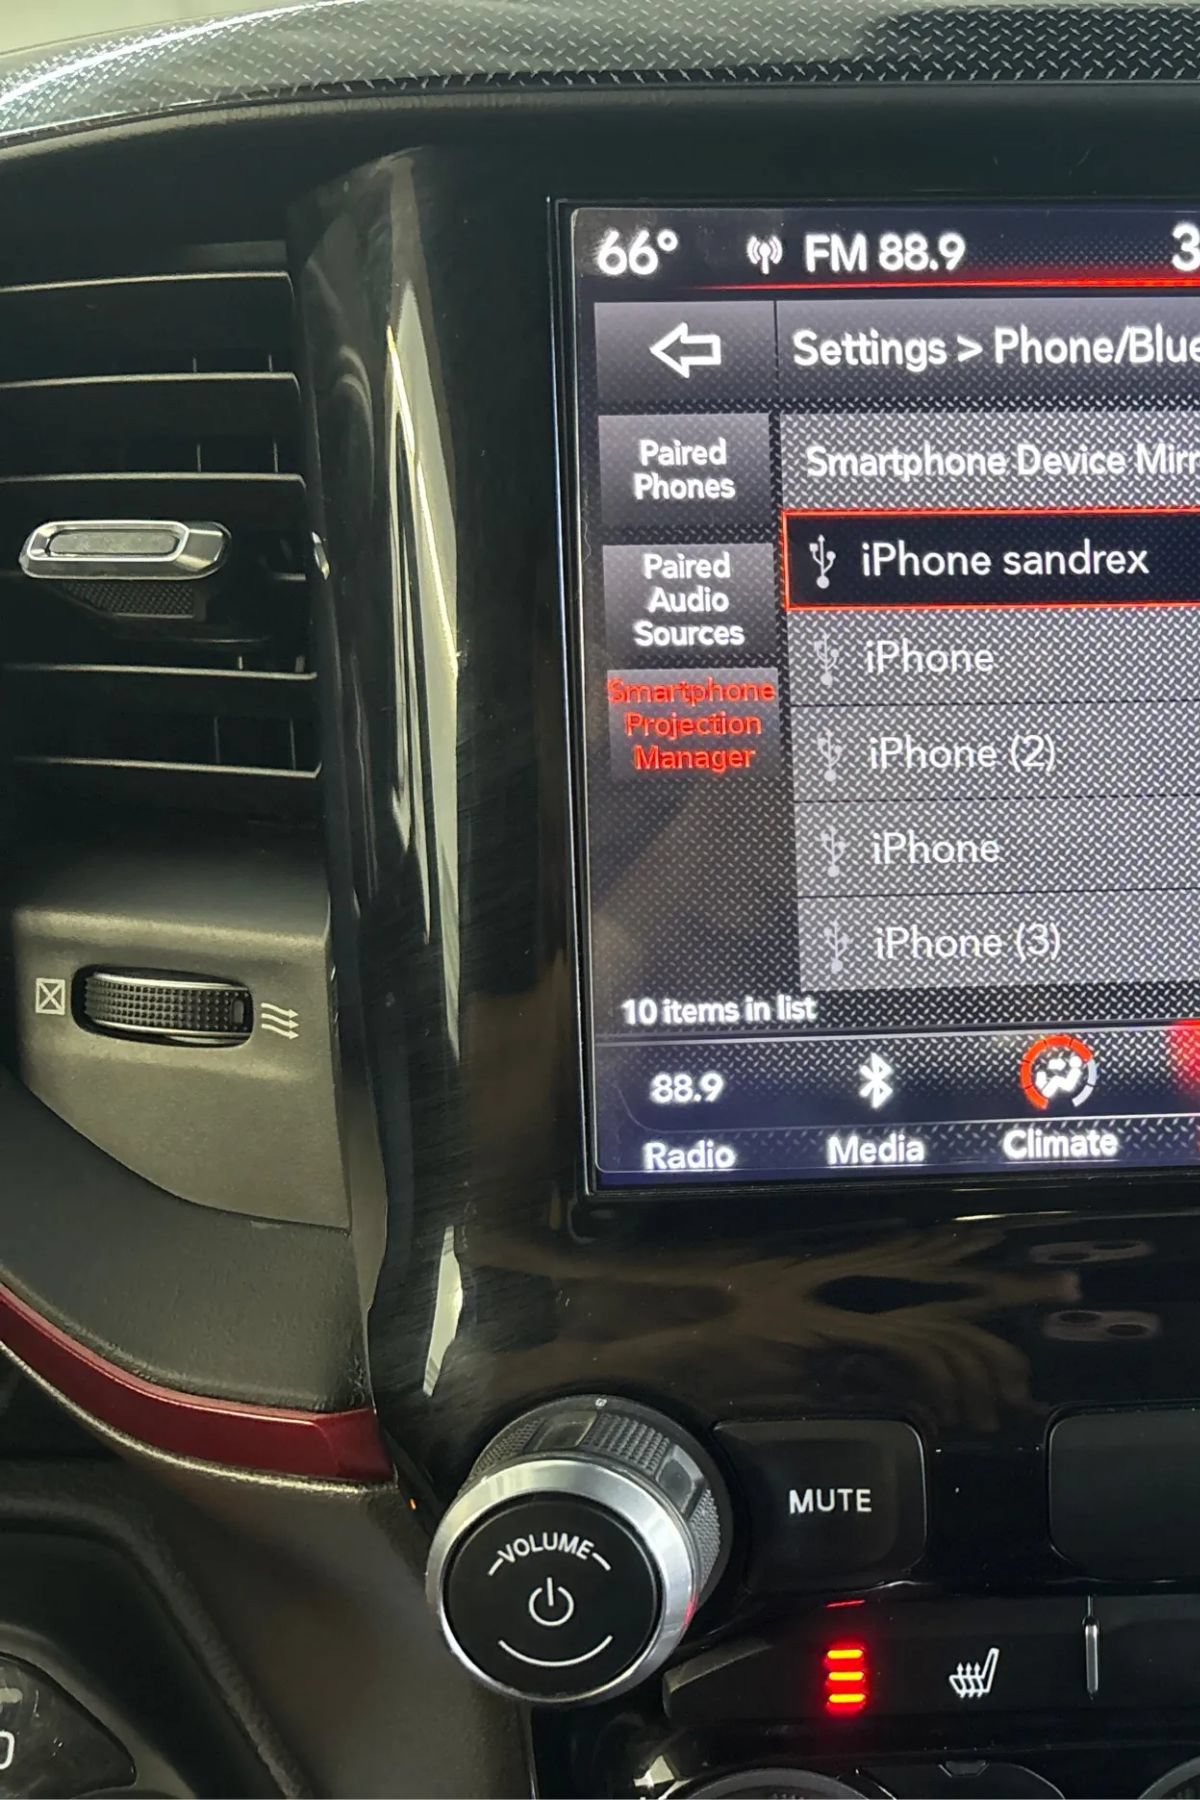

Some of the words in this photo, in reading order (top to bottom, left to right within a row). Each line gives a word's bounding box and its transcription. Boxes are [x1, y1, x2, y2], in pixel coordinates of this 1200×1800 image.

[596, 228, 679, 276] 66°
[804, 234, 867, 272] FM
[878, 231, 966, 273] 88.9
[792, 327, 948, 372] Settings
[639, 438, 727, 467] Paired
[805, 444, 1007, 482] Smartphone
[1016, 444, 1126, 478] Device
[633, 472, 736, 502] Phones
[642, 552, 731, 580] Paired
[861, 540, 992, 578] iPhone
[1002, 538, 1150, 576] sandrex
[648, 587, 729, 614] Audio
[633, 619, 745, 648] Sources
[865, 639, 995, 675] iPhone
[607, 676, 776, 707] Smartphone
[624, 711, 762, 740] Projection
[632, 745, 755, 774] Manager
[868, 735, 998, 771] iPhone
[1008, 732, 1057, 773] (2)
[871, 829, 1000, 866] iPhone
[874, 924, 1002, 961] iPhone
[1014, 922, 1062, 963] (3)
[621, 998, 657, 1025] 10
[662, 995, 740, 1025] items
[744, 994, 771, 1022] in
[776, 993, 817, 1022] list
[649, 1071, 724, 1104] 88.9
[644, 1138, 736, 1171] Radio
[827, 1132, 926, 1166] Media
[1002, 1128, 1119, 1161] Climate
[788, 1489, 873, 1515] MUTE
[499, 1533, 594, 1563] VOLUME
